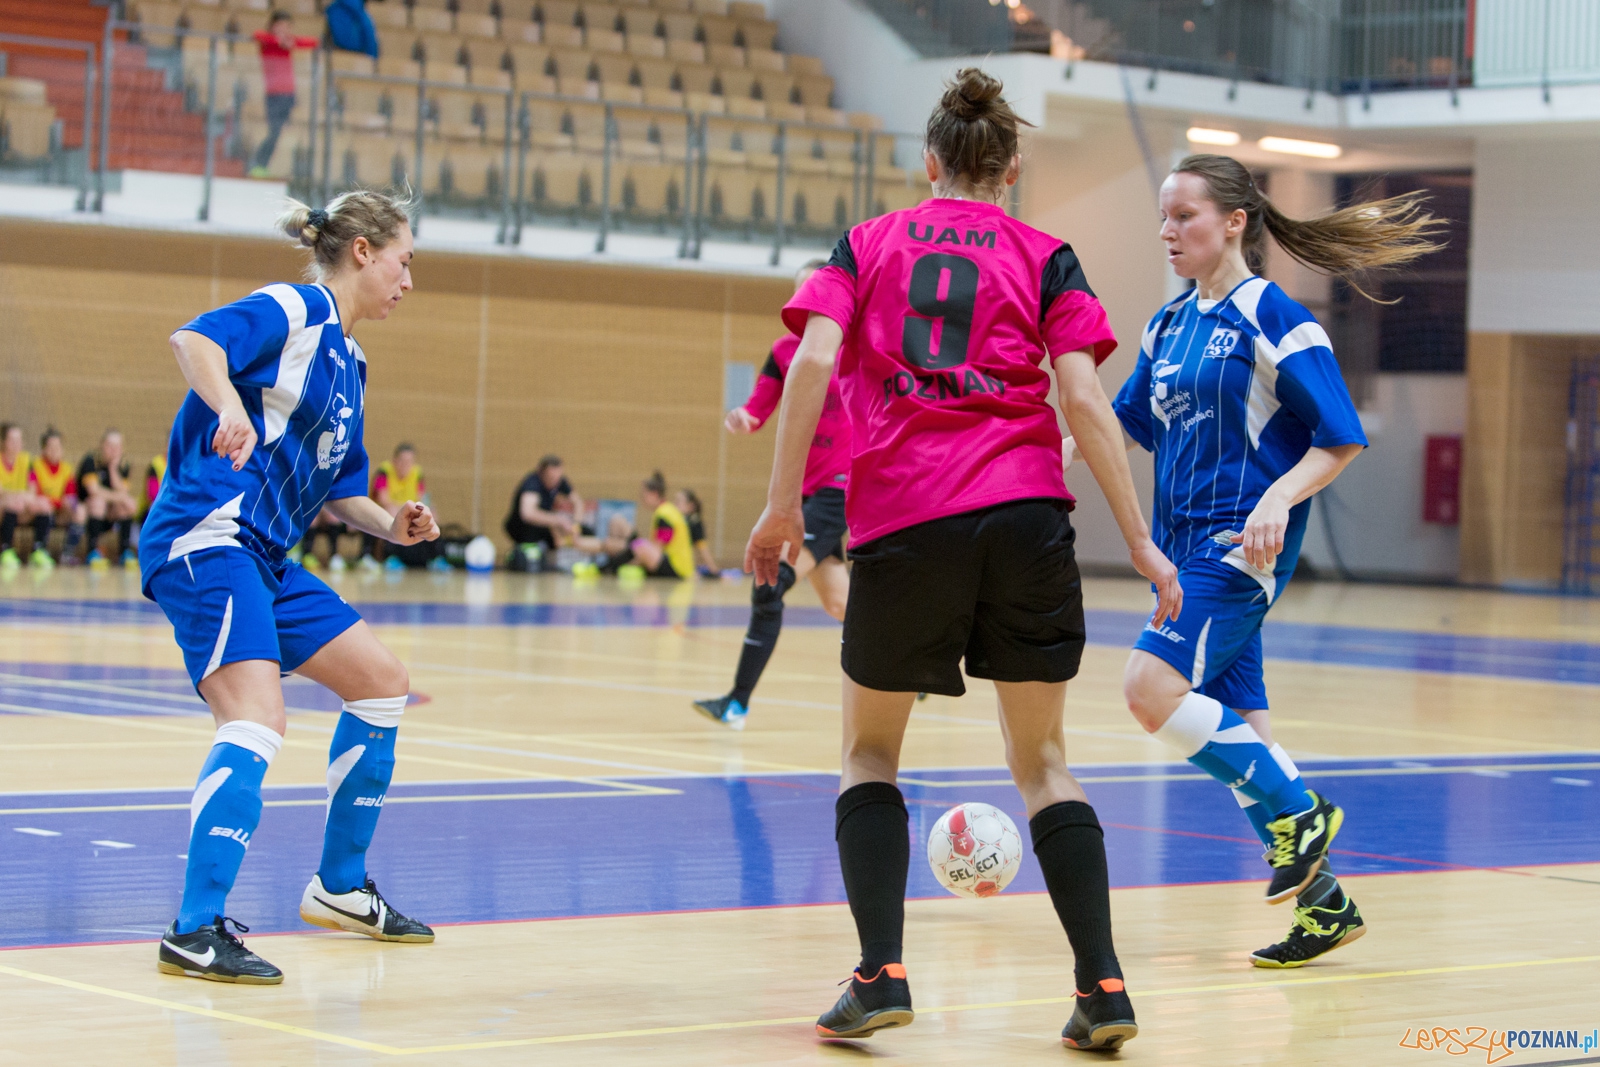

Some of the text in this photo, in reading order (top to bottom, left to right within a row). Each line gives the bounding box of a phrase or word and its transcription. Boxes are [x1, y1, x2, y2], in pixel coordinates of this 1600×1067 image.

[907, 221, 997, 249] UAM
[902, 252, 979, 371] 9
[949, 852, 1000, 882] SELECT
